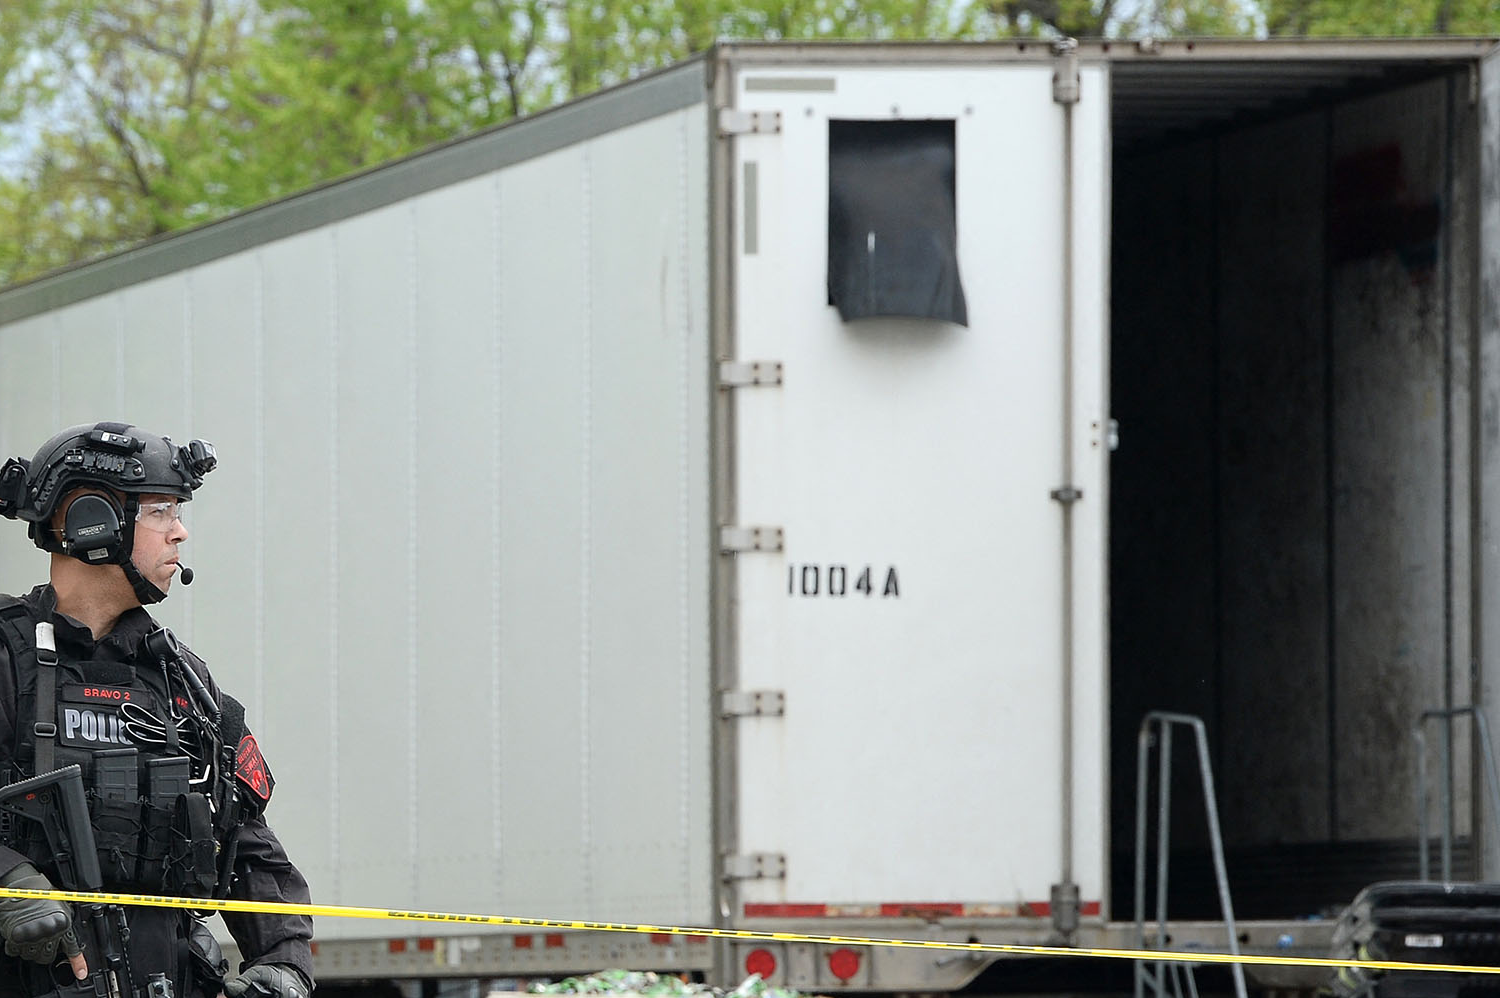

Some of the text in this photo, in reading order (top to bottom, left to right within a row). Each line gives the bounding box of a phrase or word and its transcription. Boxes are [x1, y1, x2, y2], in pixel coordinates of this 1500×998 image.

[788, 566, 899, 596] 1004A
[83, 687, 131, 701] BRAVO 2
